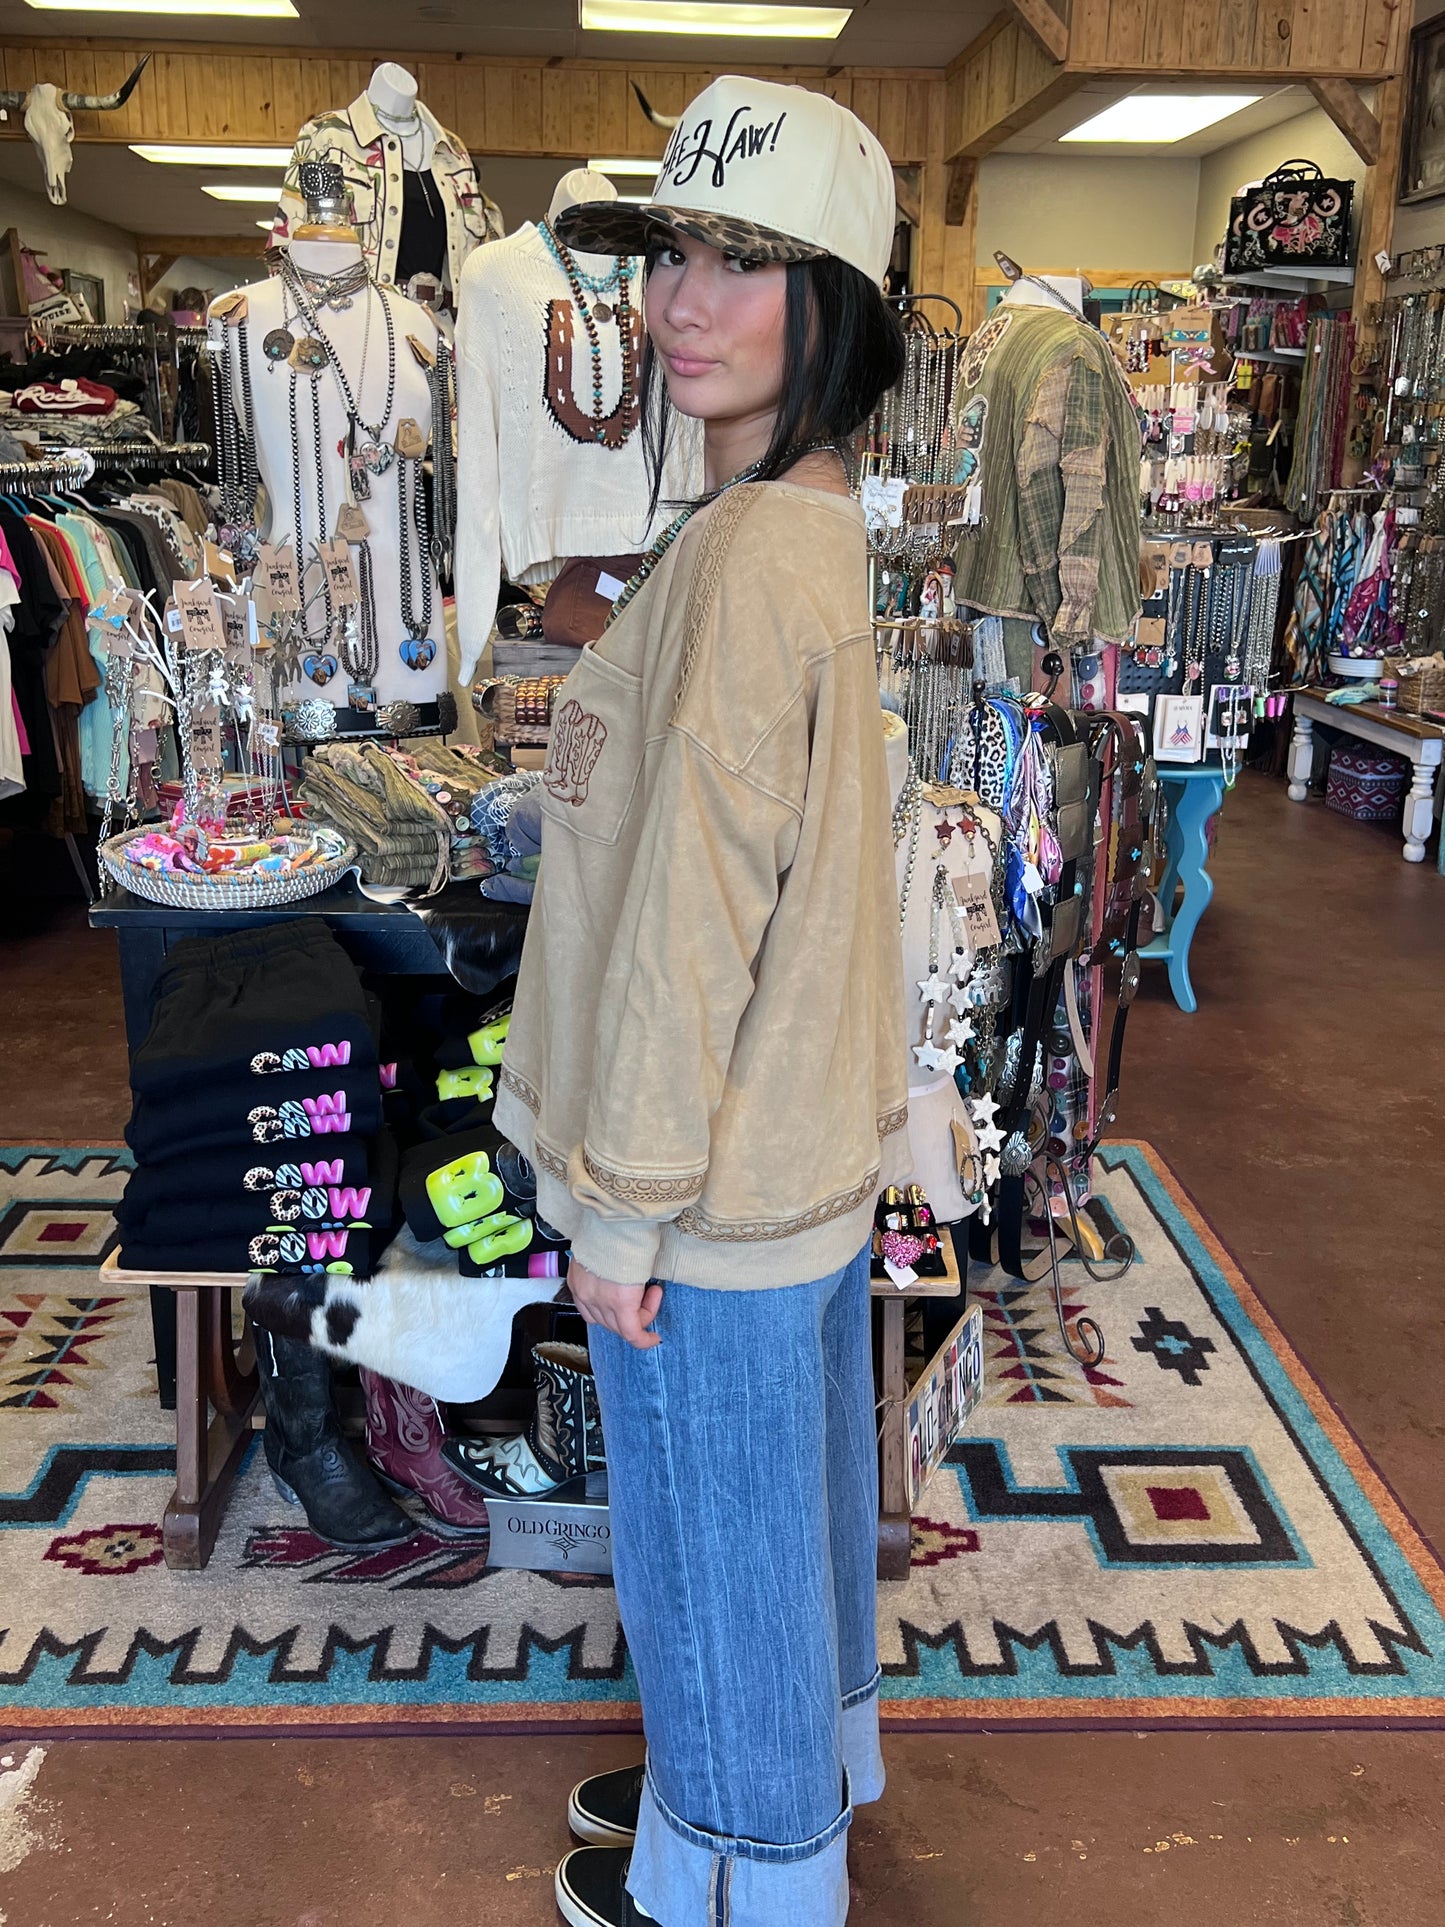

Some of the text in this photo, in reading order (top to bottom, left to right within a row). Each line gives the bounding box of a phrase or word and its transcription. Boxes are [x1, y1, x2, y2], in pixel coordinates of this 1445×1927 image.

[192, 717, 217, 726] unkyard
[269, 1187, 372, 1221] COW
[248, 1229, 350, 1266] COW
